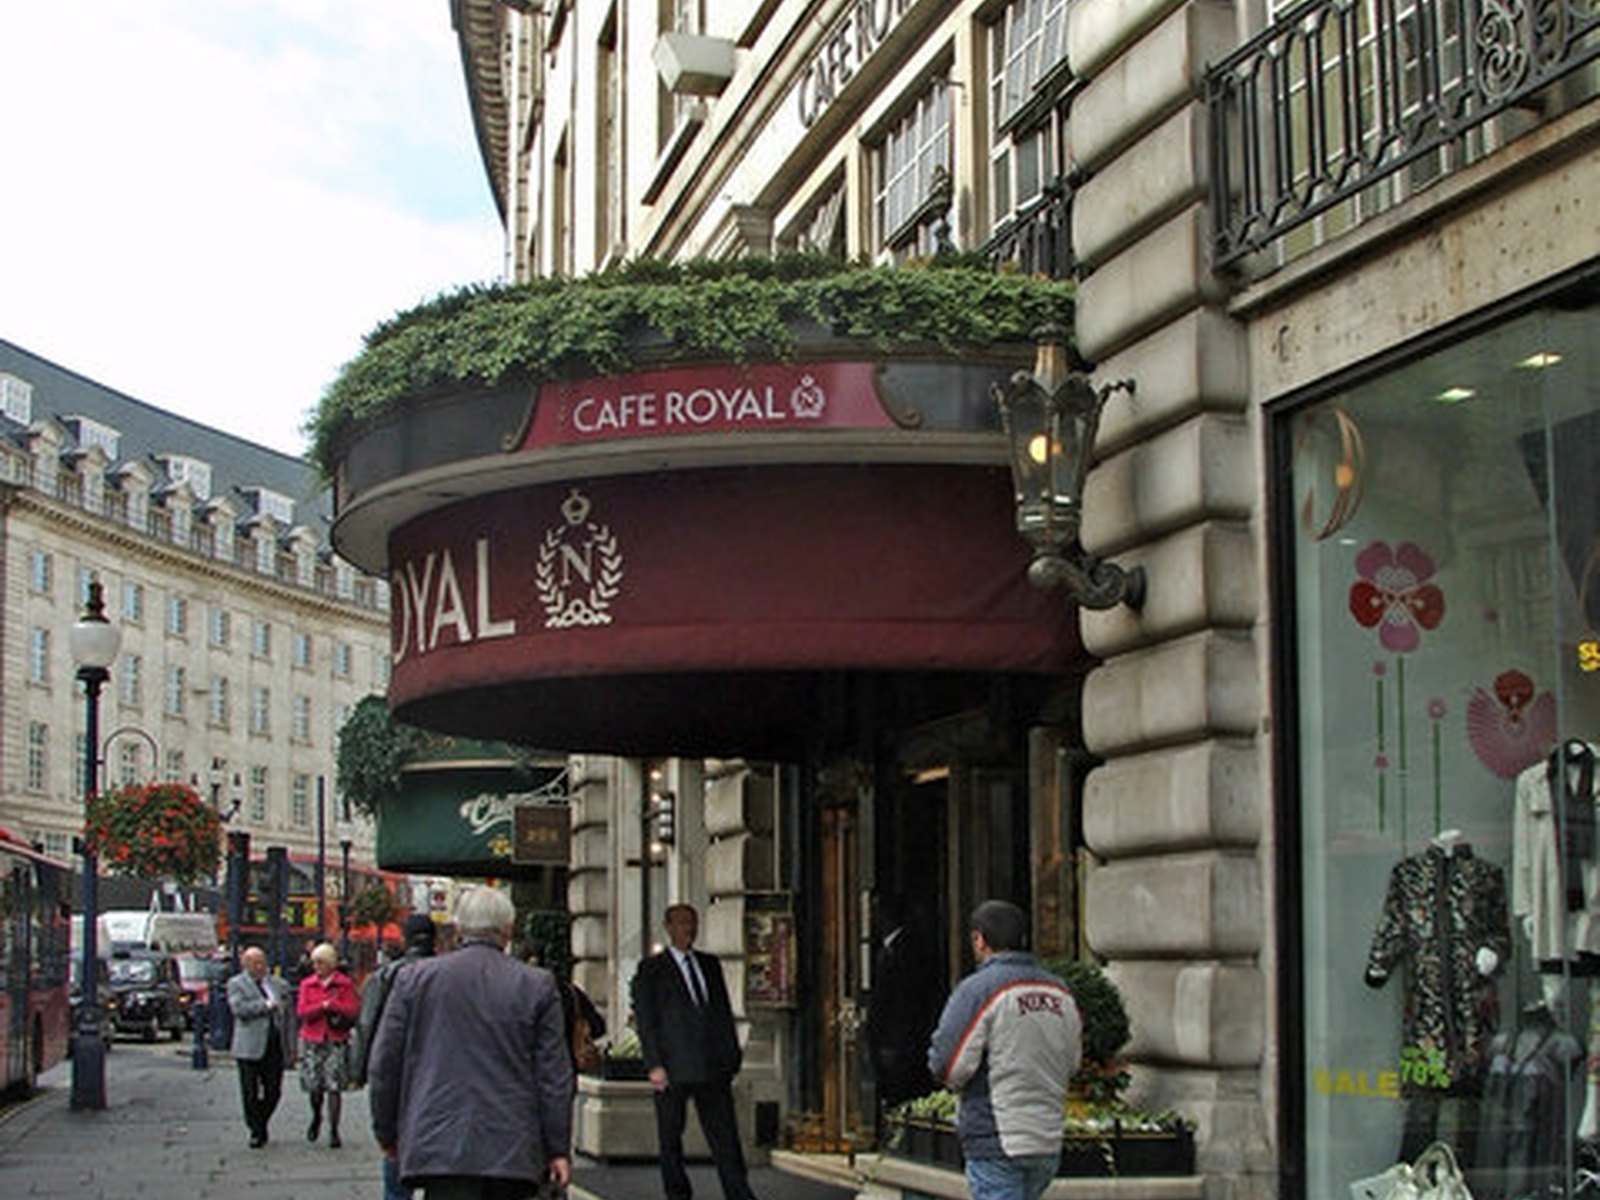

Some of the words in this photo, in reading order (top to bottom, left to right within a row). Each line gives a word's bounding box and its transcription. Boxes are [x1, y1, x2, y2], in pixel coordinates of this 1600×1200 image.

[798, 17, 853, 129] CAFE
[573, 394, 657, 432] CAFE
[665, 386, 785, 425] ROYAL
[559, 541, 594, 587] N
[1017, 991, 1063, 1017] NIKE
[1314, 1067, 1399, 1099] SALE
